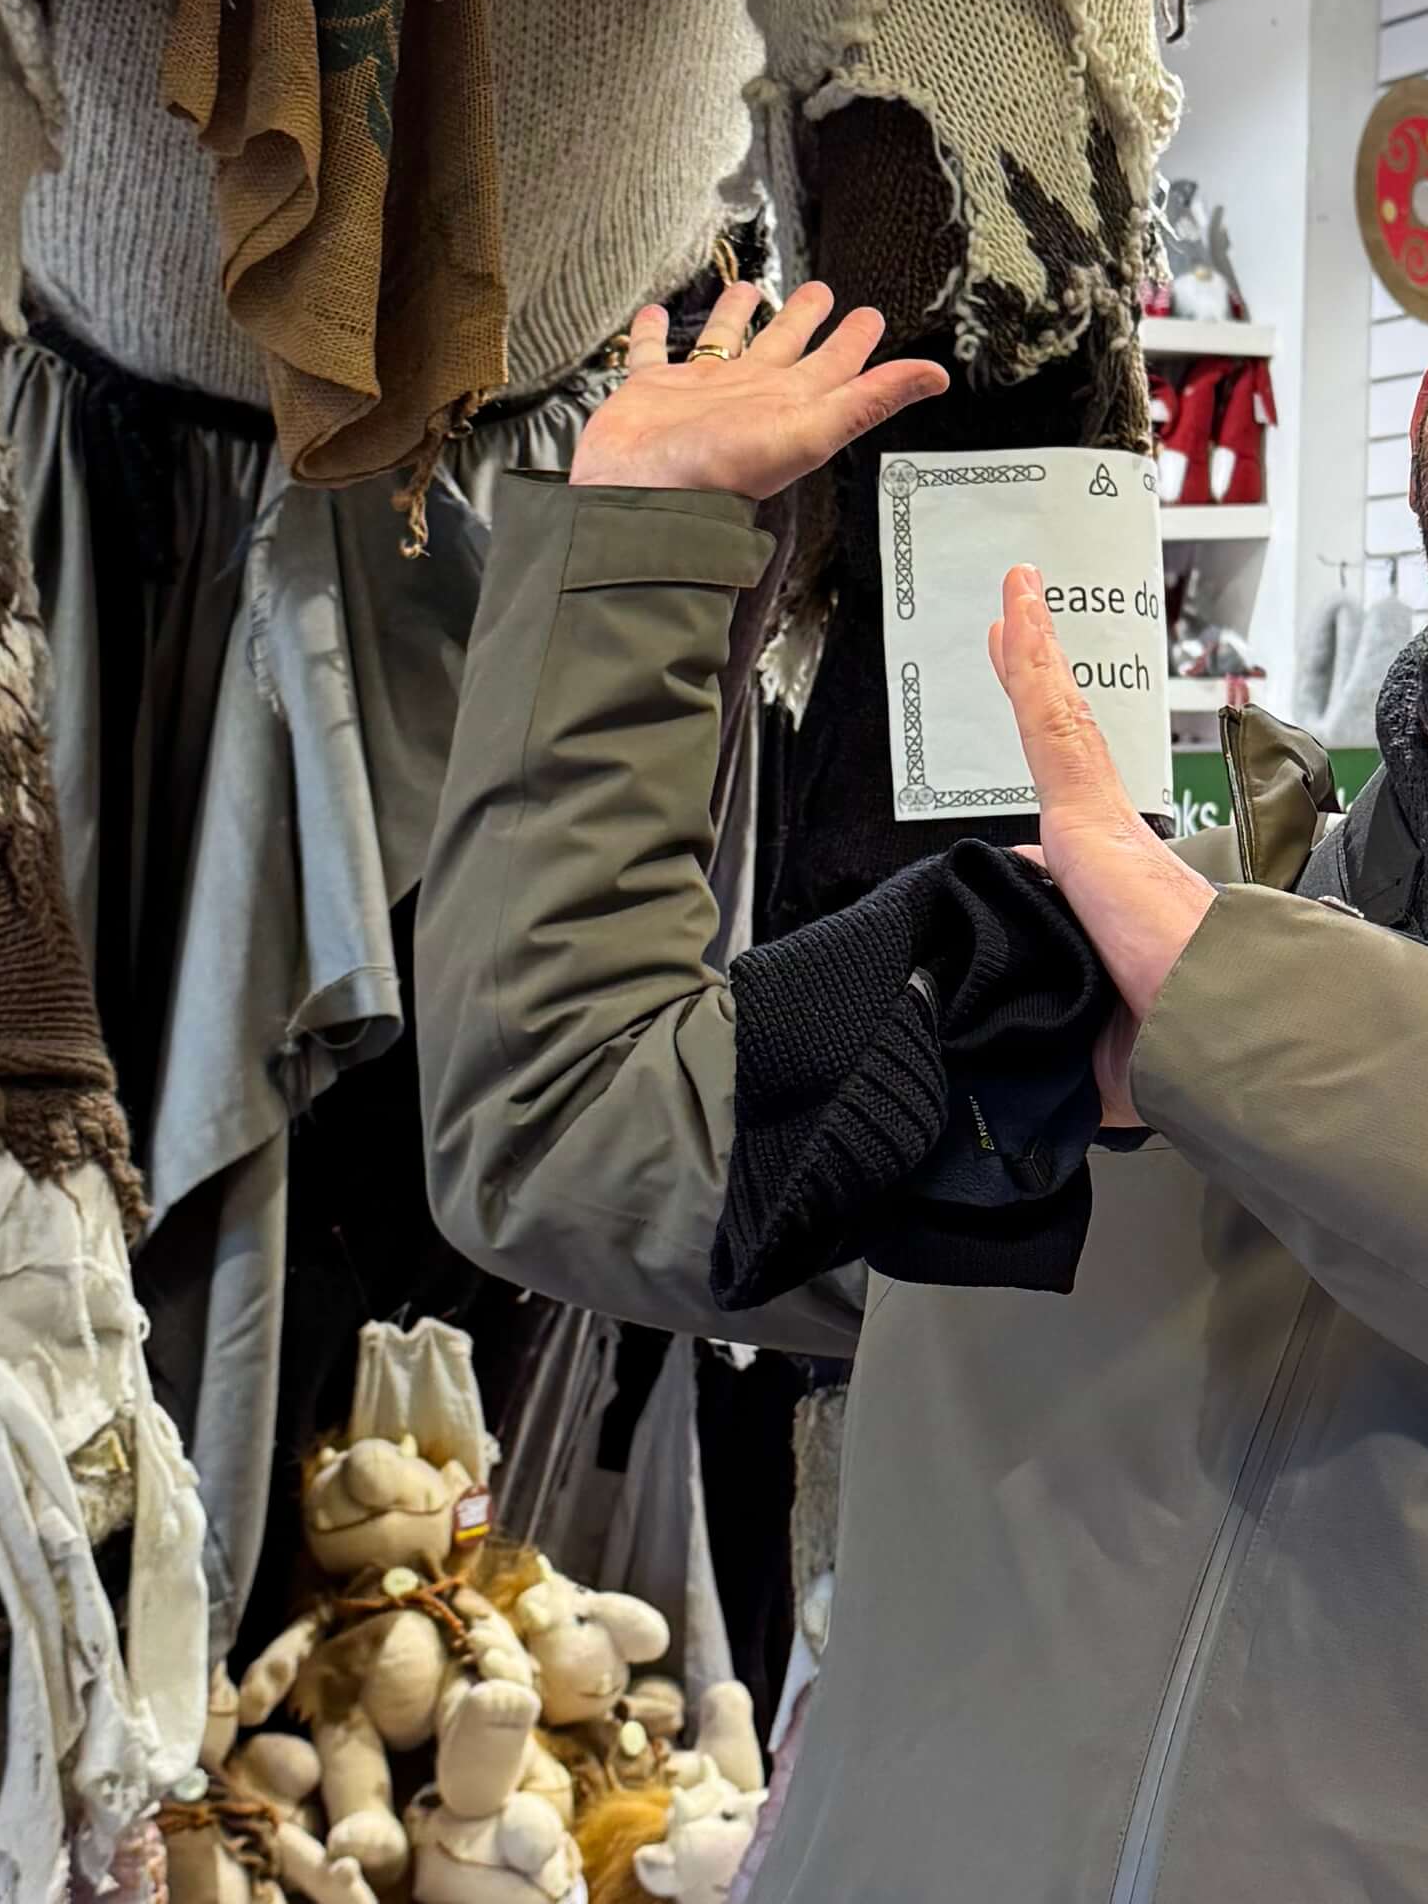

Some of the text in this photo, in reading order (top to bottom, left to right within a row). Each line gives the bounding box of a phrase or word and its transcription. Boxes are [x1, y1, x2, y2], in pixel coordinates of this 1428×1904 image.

[1044, 580, 1160, 620] ease do
[1071, 652, 1150, 691] ouch
